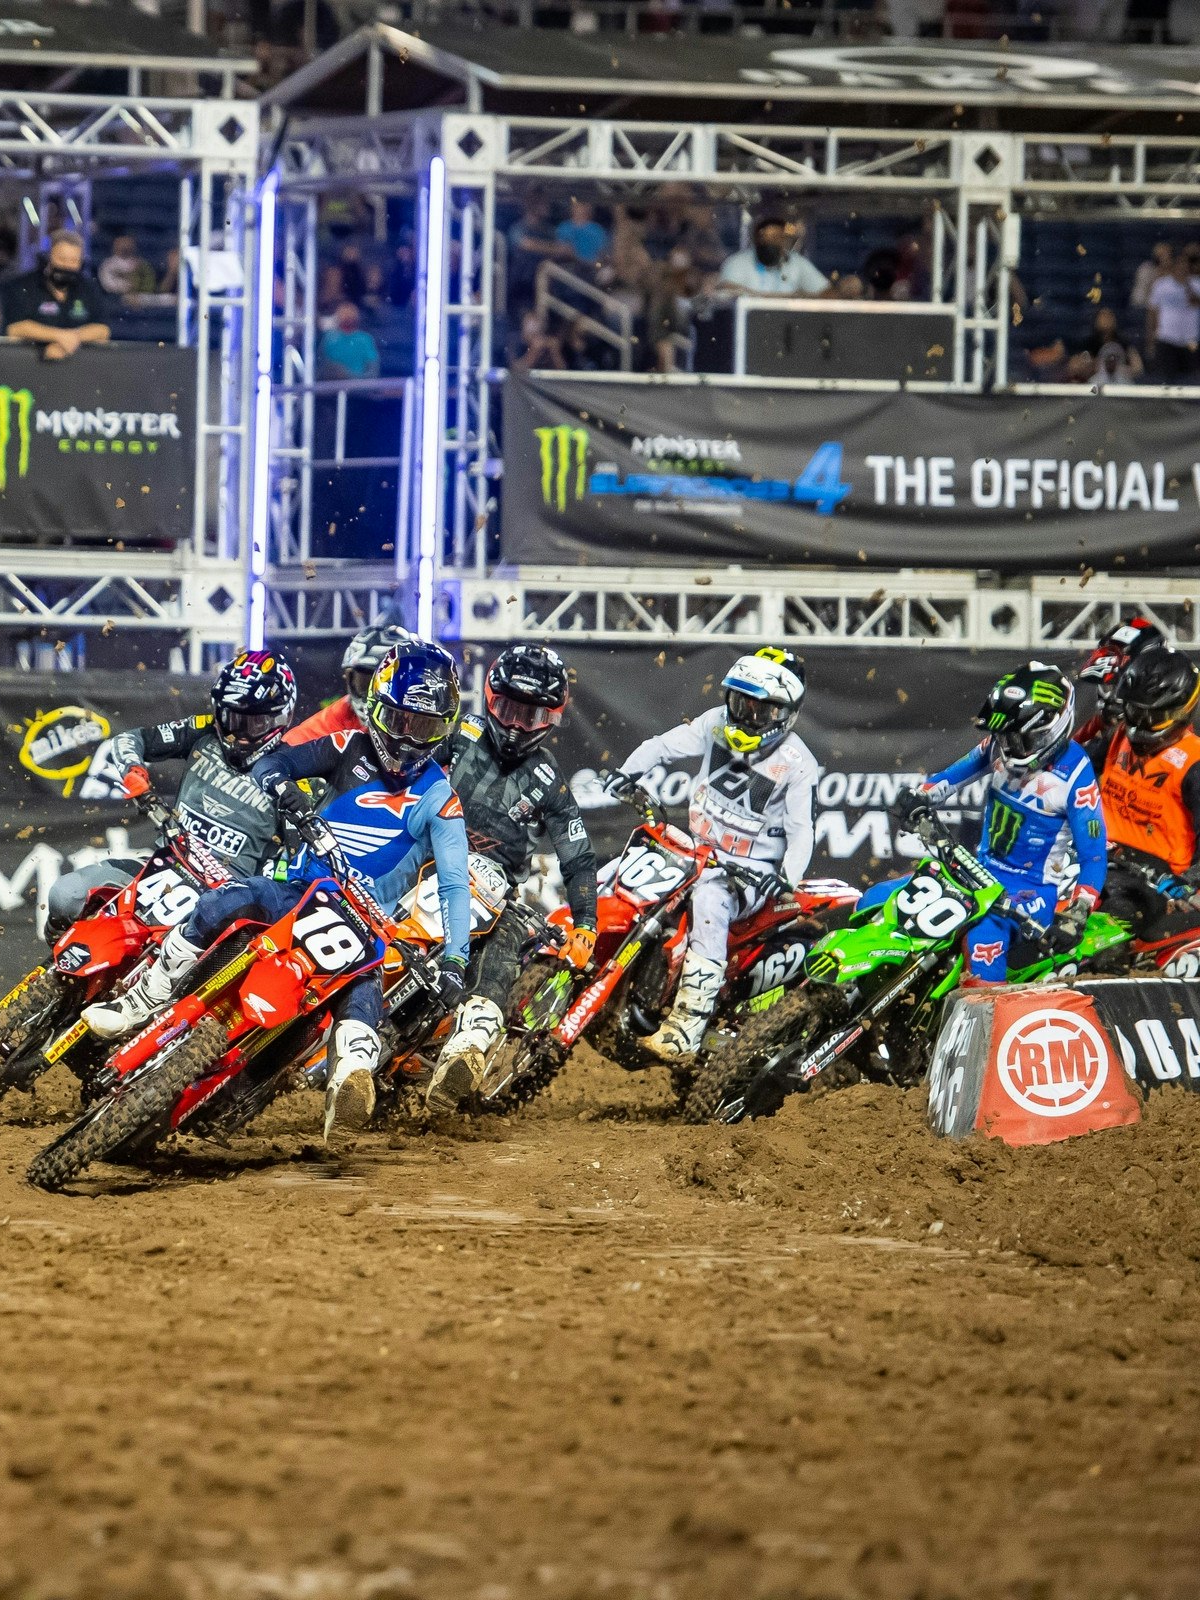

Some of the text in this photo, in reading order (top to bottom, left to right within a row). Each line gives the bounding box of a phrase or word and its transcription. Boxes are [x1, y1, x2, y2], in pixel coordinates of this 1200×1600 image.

[36, 407, 181, 439] MONSTER
[58, 438, 159, 454] ENERGY
[796, 441, 852, 516] 4
[865, 455, 955, 507] THE
[970, 456, 1180, 512] OFFICIAL
[211, 768, 274, 814] RACING
[136, 868, 200, 926] 49
[619, 846, 687, 902] 162
[896, 875, 968, 938] 30
[292, 907, 366, 971] 18
[576, 933, 594, 950] FLY
[749, 942, 806, 998] 162
[870, 967, 922, 1015] PRO CIRCUIT
[120, 1007, 176, 1055] DUNLOP
[1019, 1040, 1088, 1087] RM
